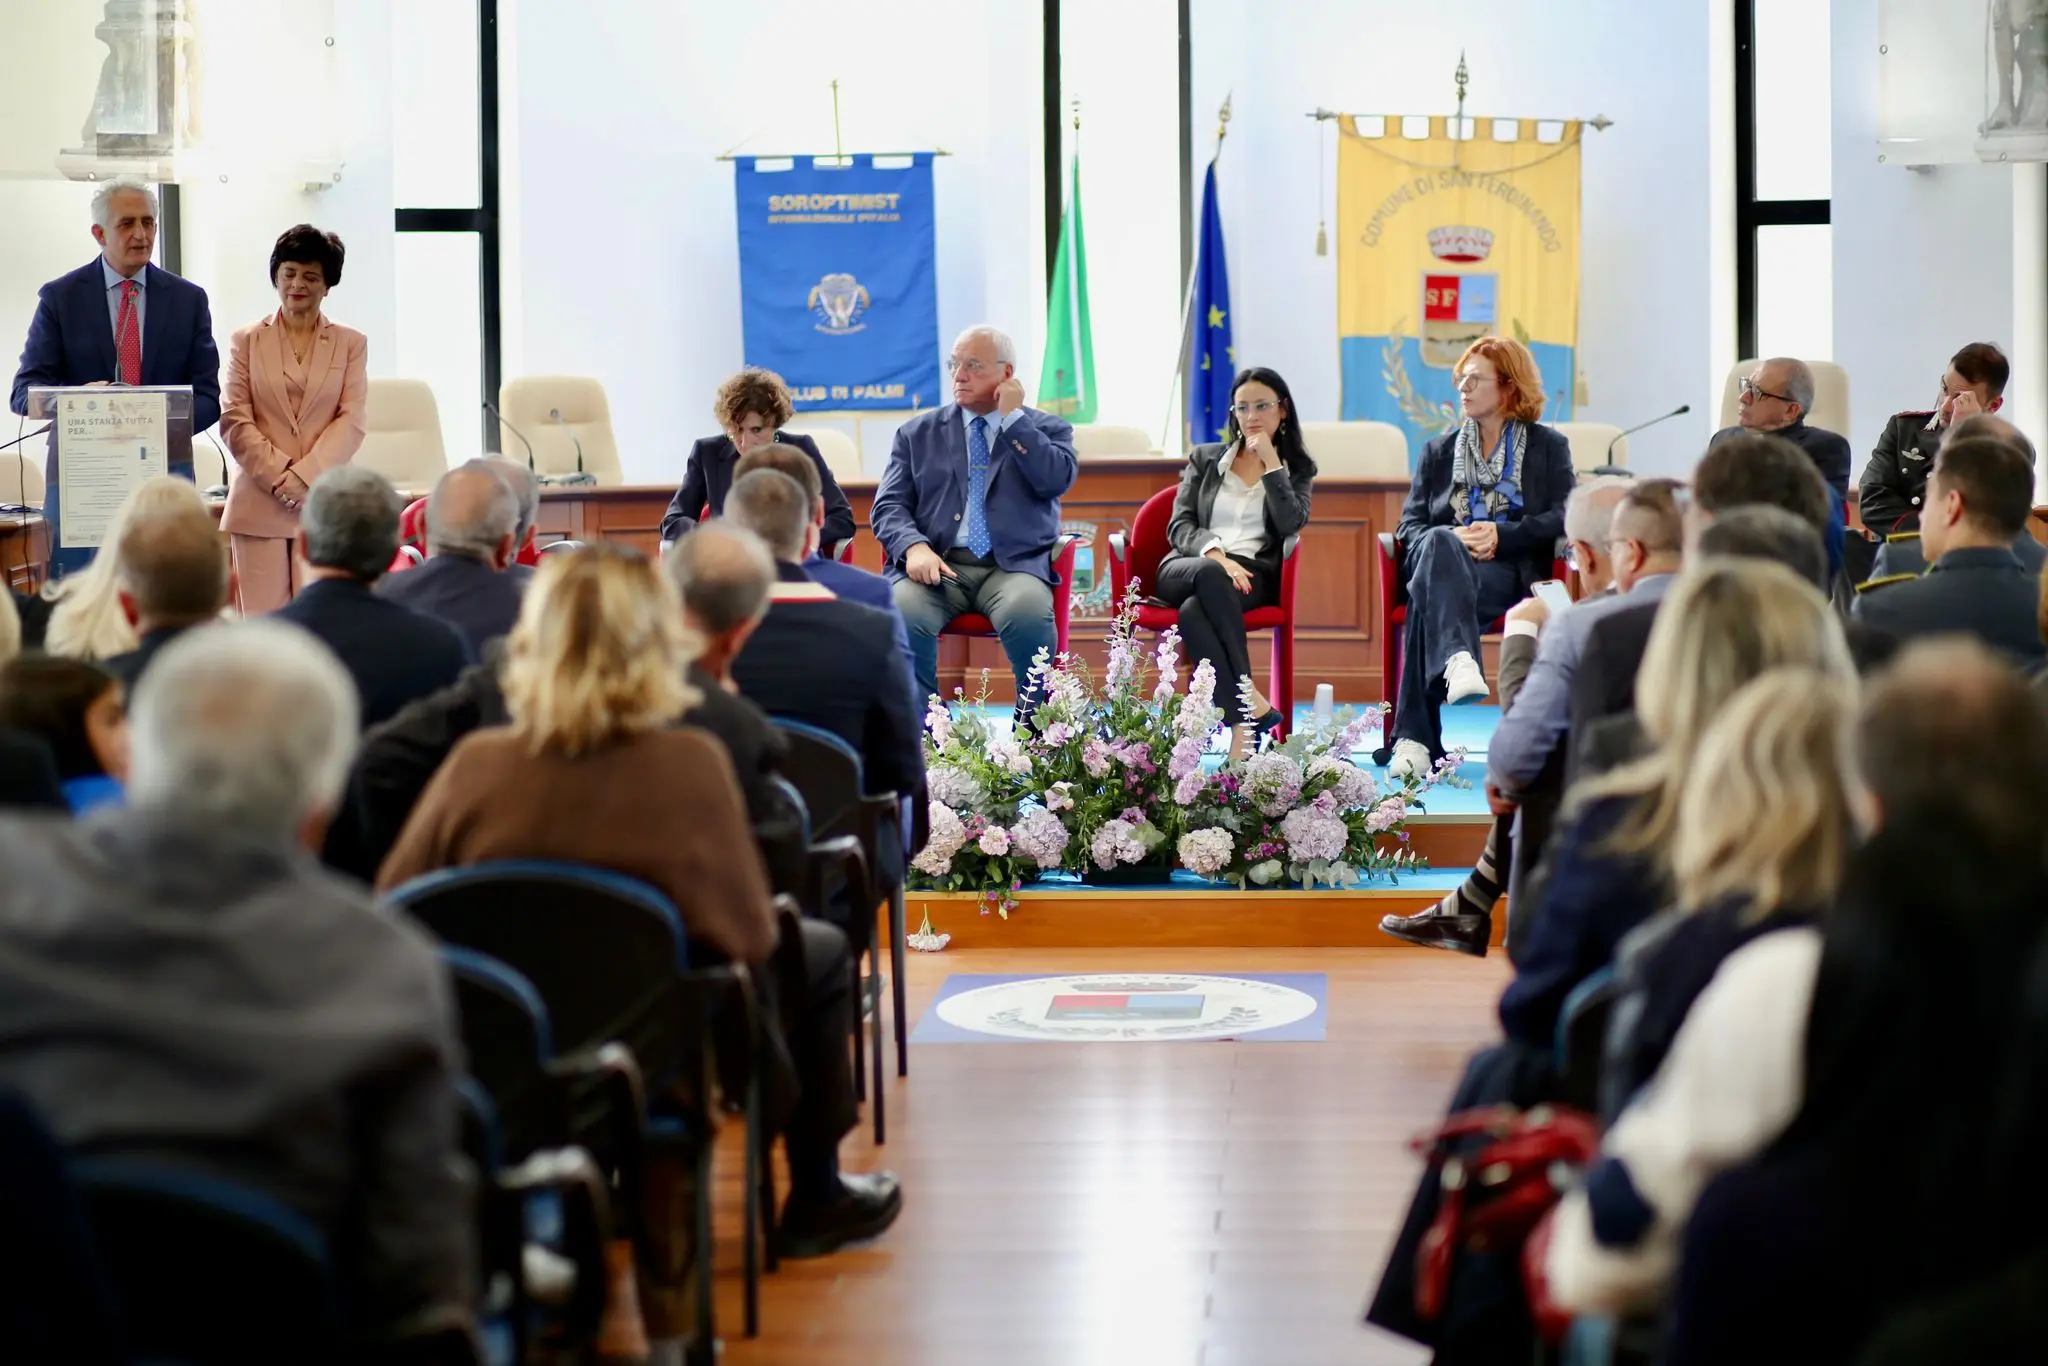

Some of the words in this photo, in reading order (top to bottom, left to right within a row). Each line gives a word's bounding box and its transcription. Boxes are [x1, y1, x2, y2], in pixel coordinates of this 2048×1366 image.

[769, 193, 899, 211] SOROPTIMIST
[1360, 184, 1415, 248] COMUNE
[1414, 174, 1434, 196] DI
[1438, 169, 1472, 189] SAN
[67, 418, 86, 426] UNA
[88, 417, 123, 426] STANZA
[124, 417, 153, 425] TUTTA
